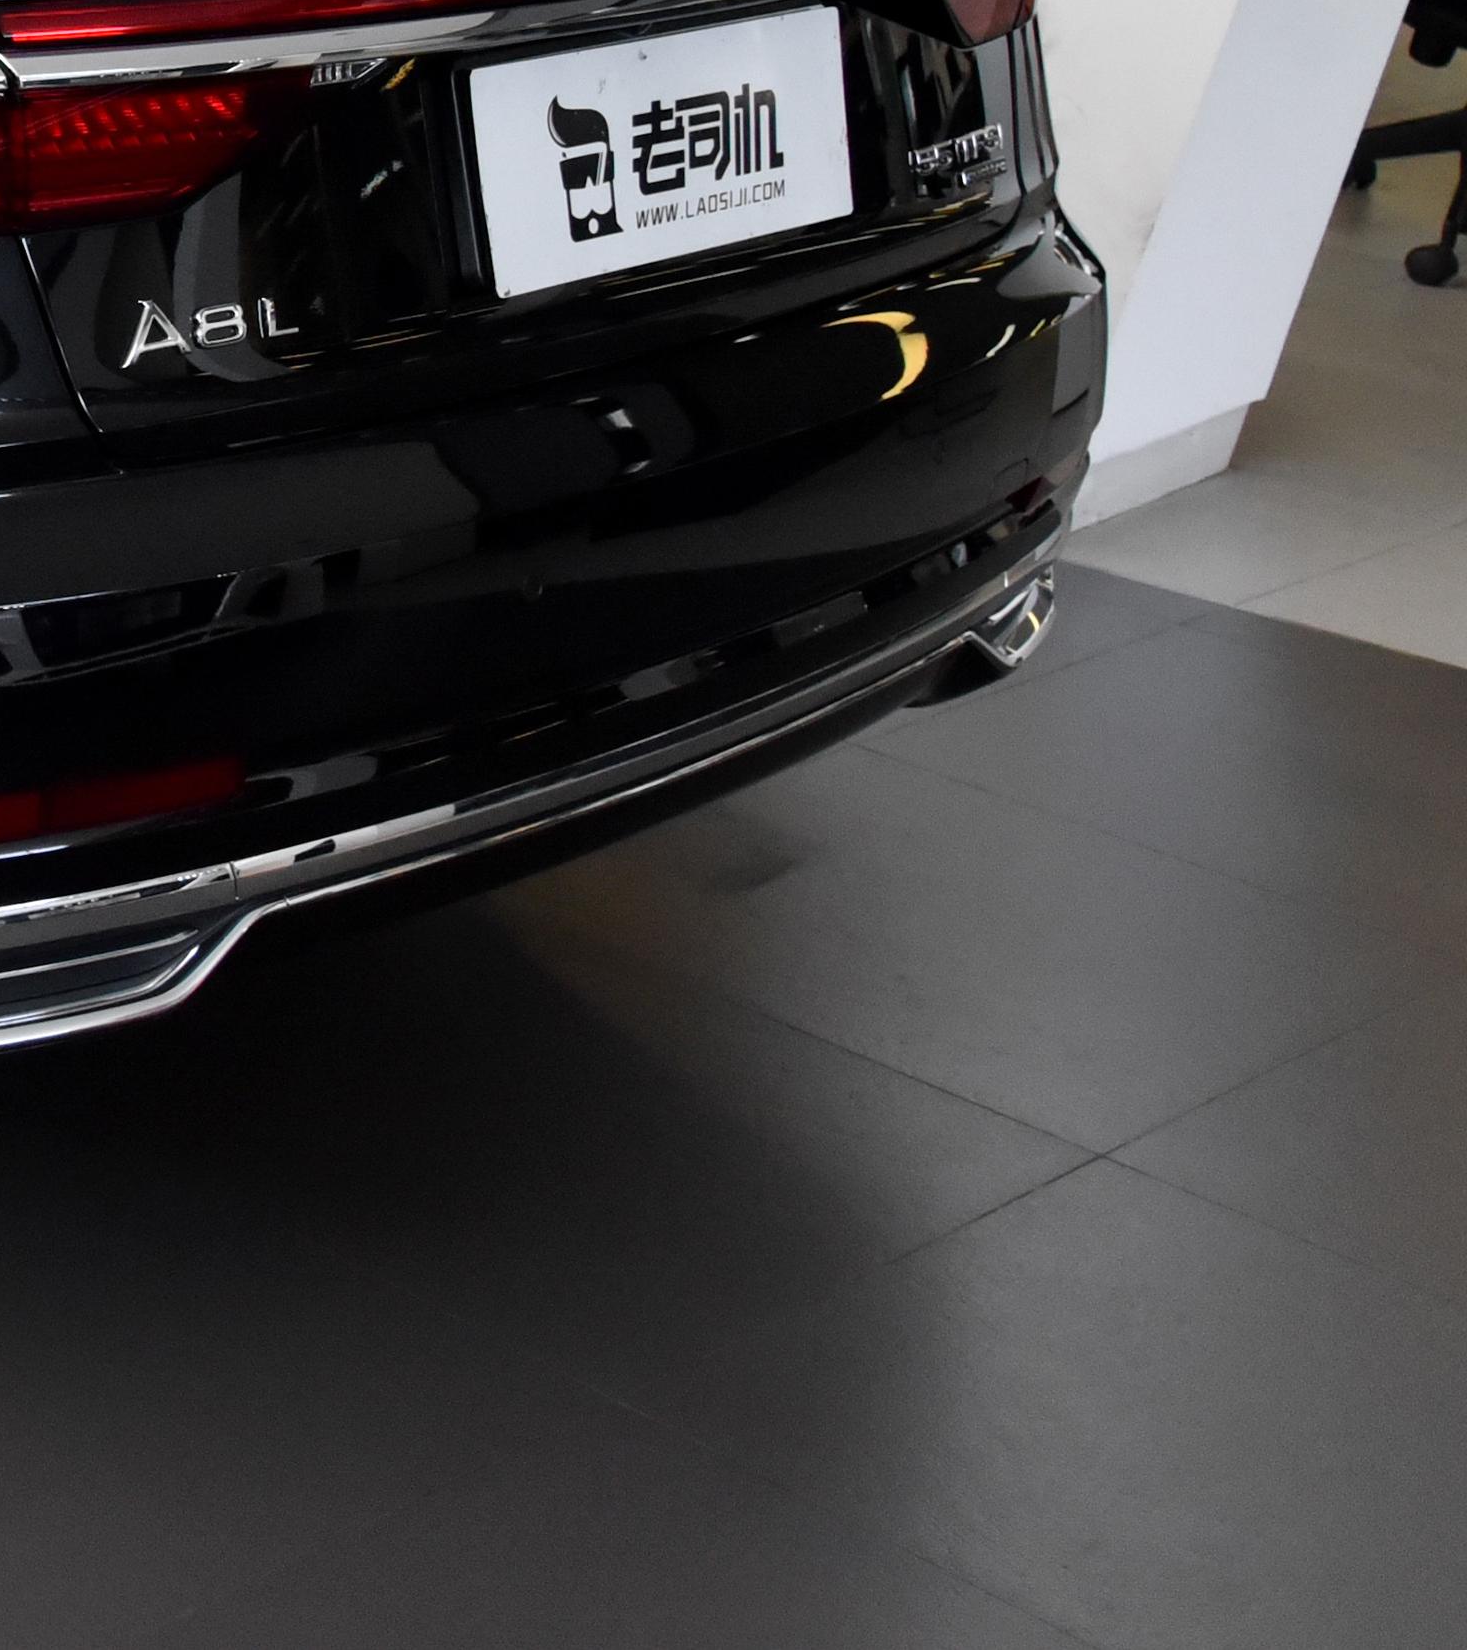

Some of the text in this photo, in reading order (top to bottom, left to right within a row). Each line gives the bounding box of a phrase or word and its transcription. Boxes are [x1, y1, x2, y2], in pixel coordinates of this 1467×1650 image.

[632, 83, 784, 196] 老司机
[635, 179, 786, 229] WWW.LAOSIJI.COM
[256, 297, 300, 339] L
